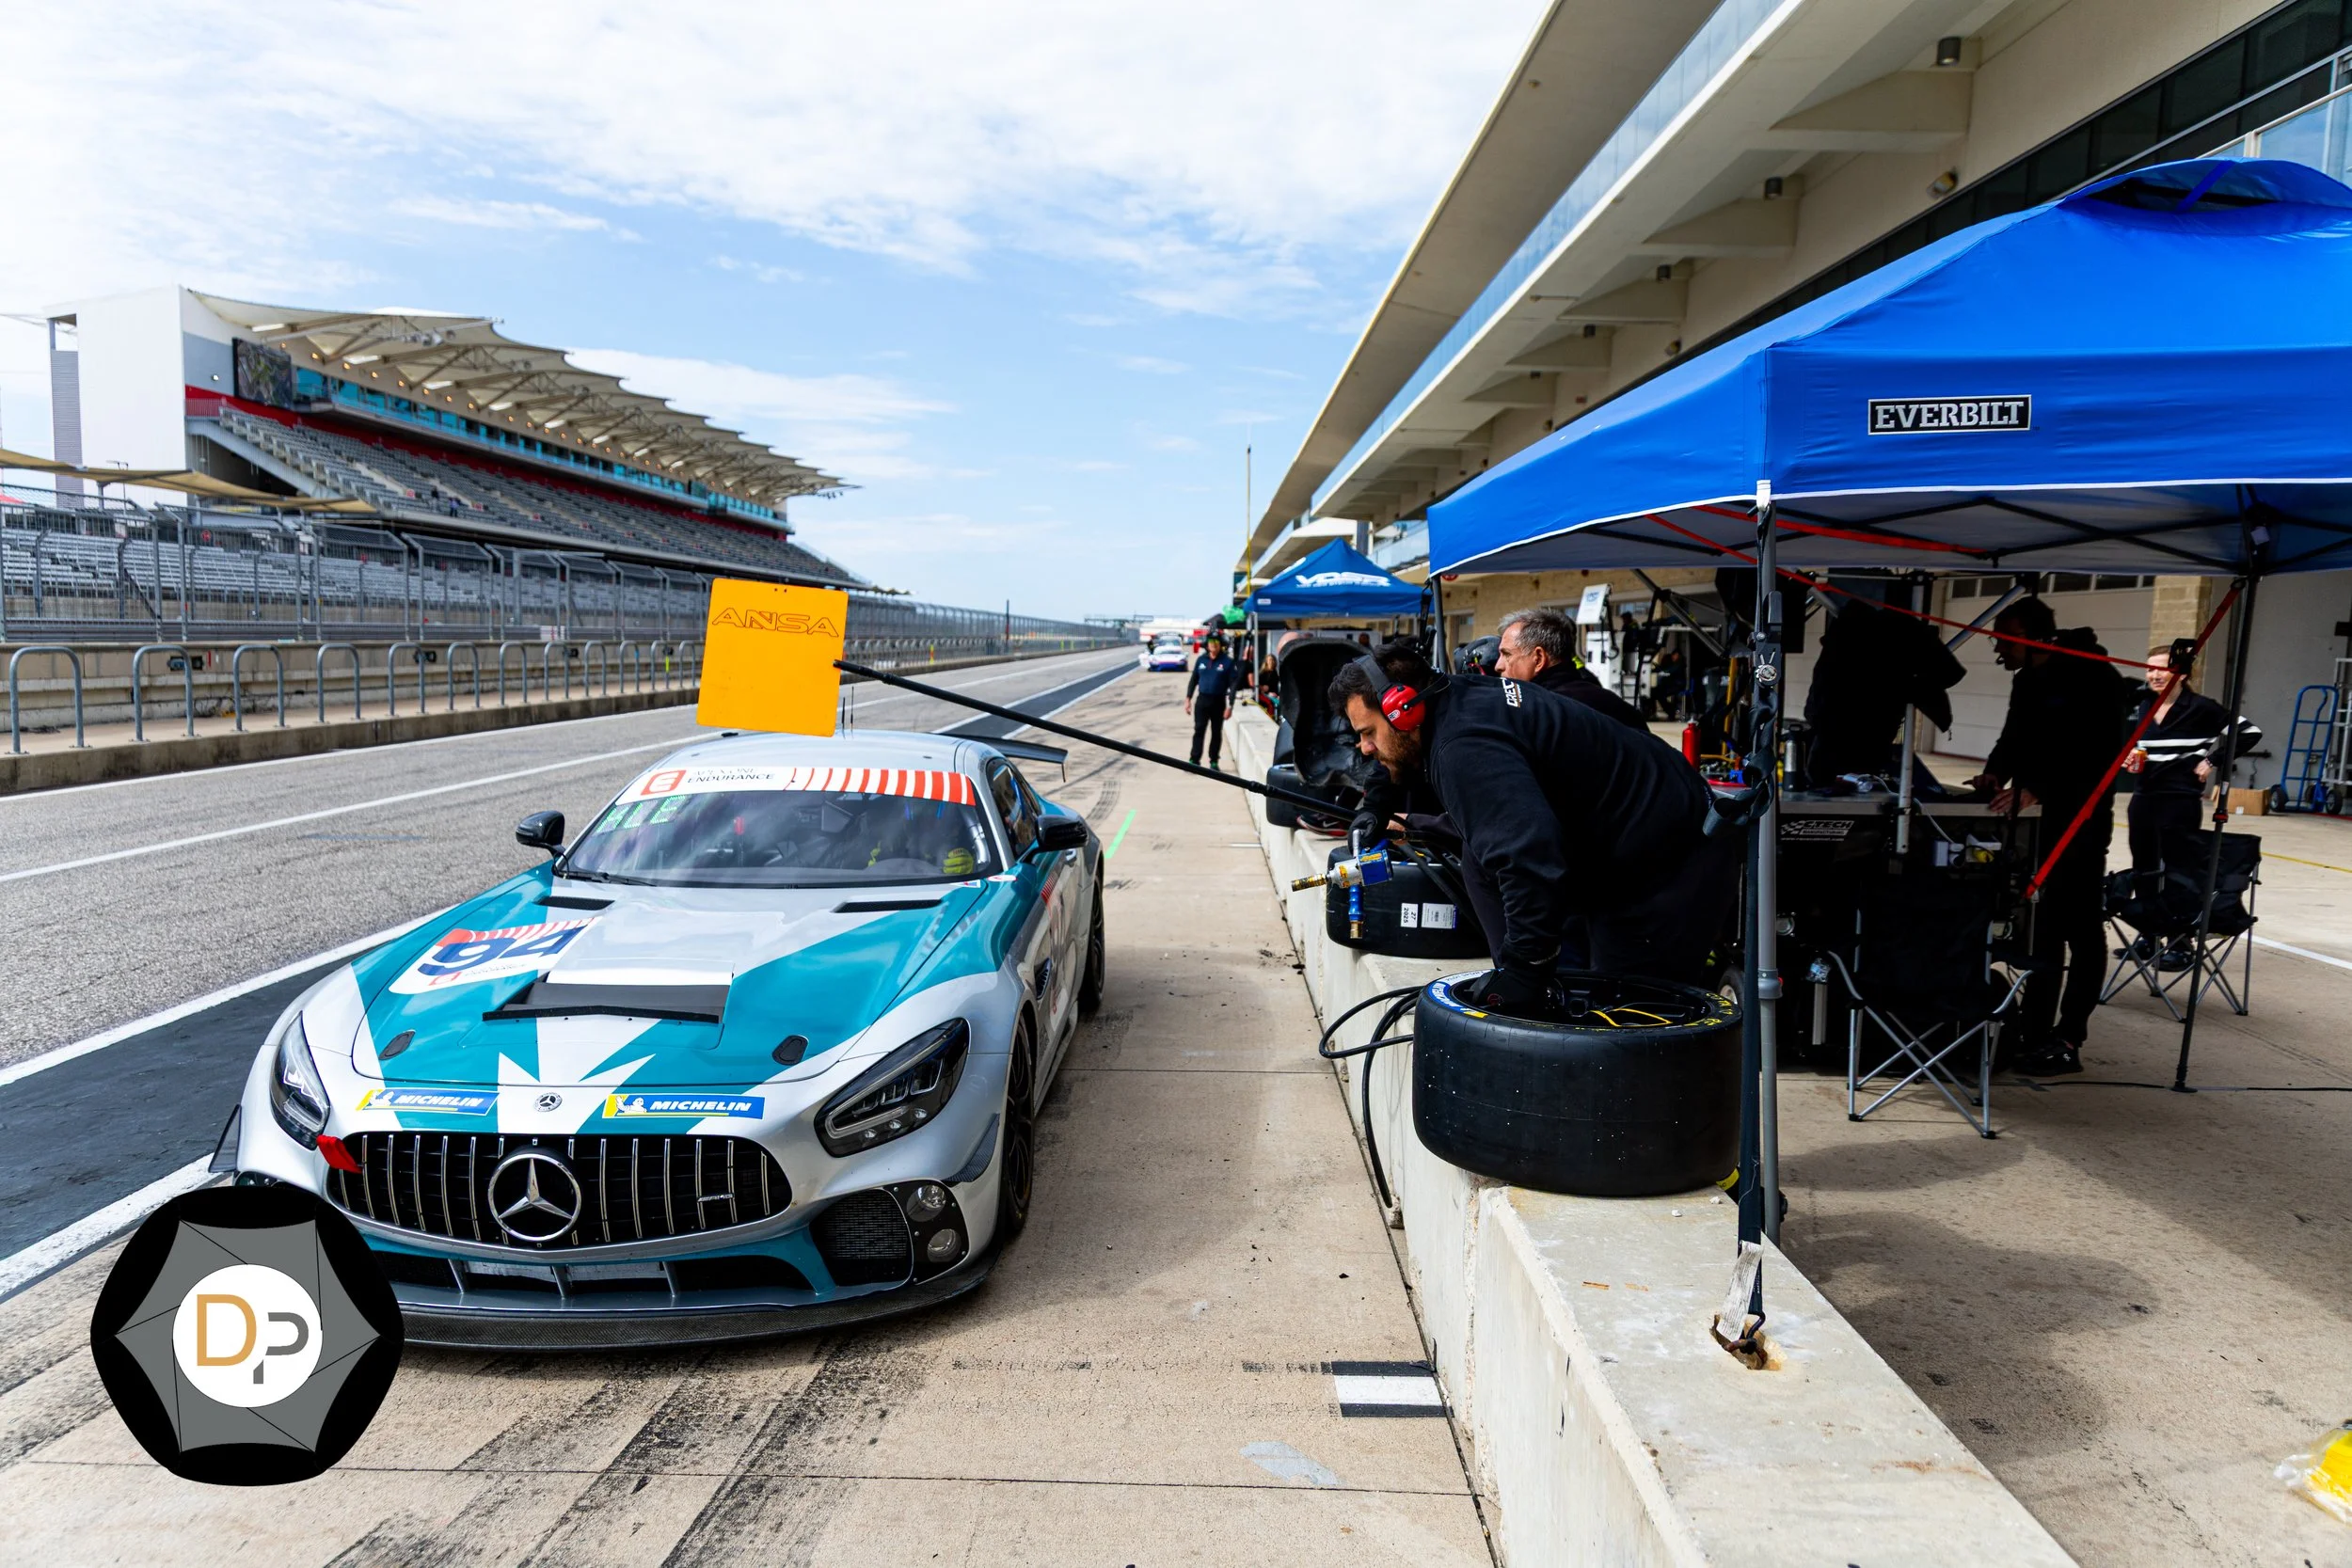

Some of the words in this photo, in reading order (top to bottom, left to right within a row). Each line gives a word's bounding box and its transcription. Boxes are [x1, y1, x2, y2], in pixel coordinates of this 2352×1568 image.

[1875, 401, 2025, 429] EVERBILT
[712, 607, 839, 638] ANSA
[687, 773, 776, 784] ENDURANCE
[417, 924, 588, 976] 94
[393, 1094, 485, 1108] MICHELIN
[649, 1100, 753, 1112] MICHELIN
